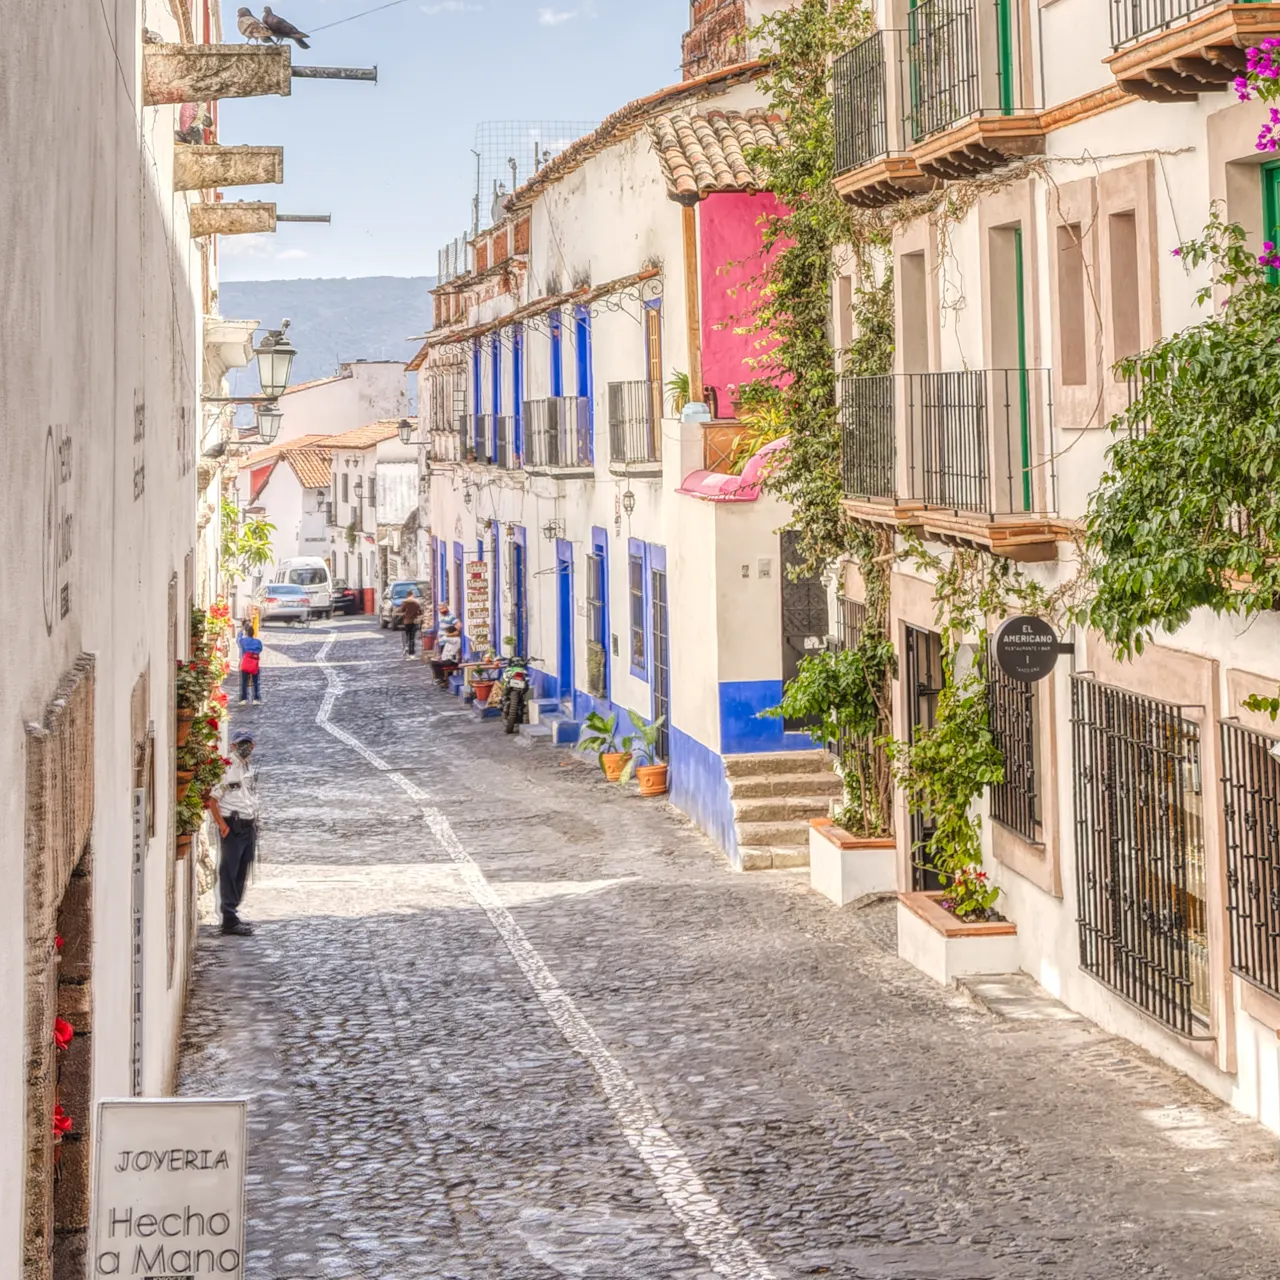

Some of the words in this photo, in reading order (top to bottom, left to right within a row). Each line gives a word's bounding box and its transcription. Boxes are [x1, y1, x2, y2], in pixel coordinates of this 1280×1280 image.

[1003, 634, 1053, 643] AMERICANO
[1022, 624, 1034, 633] EL
[114, 1148, 230, 1174] JOYERIA
[108, 1205, 231, 1238] Hecho
[96, 1250, 120, 1276] a
[131, 1243, 240, 1276] Mano
